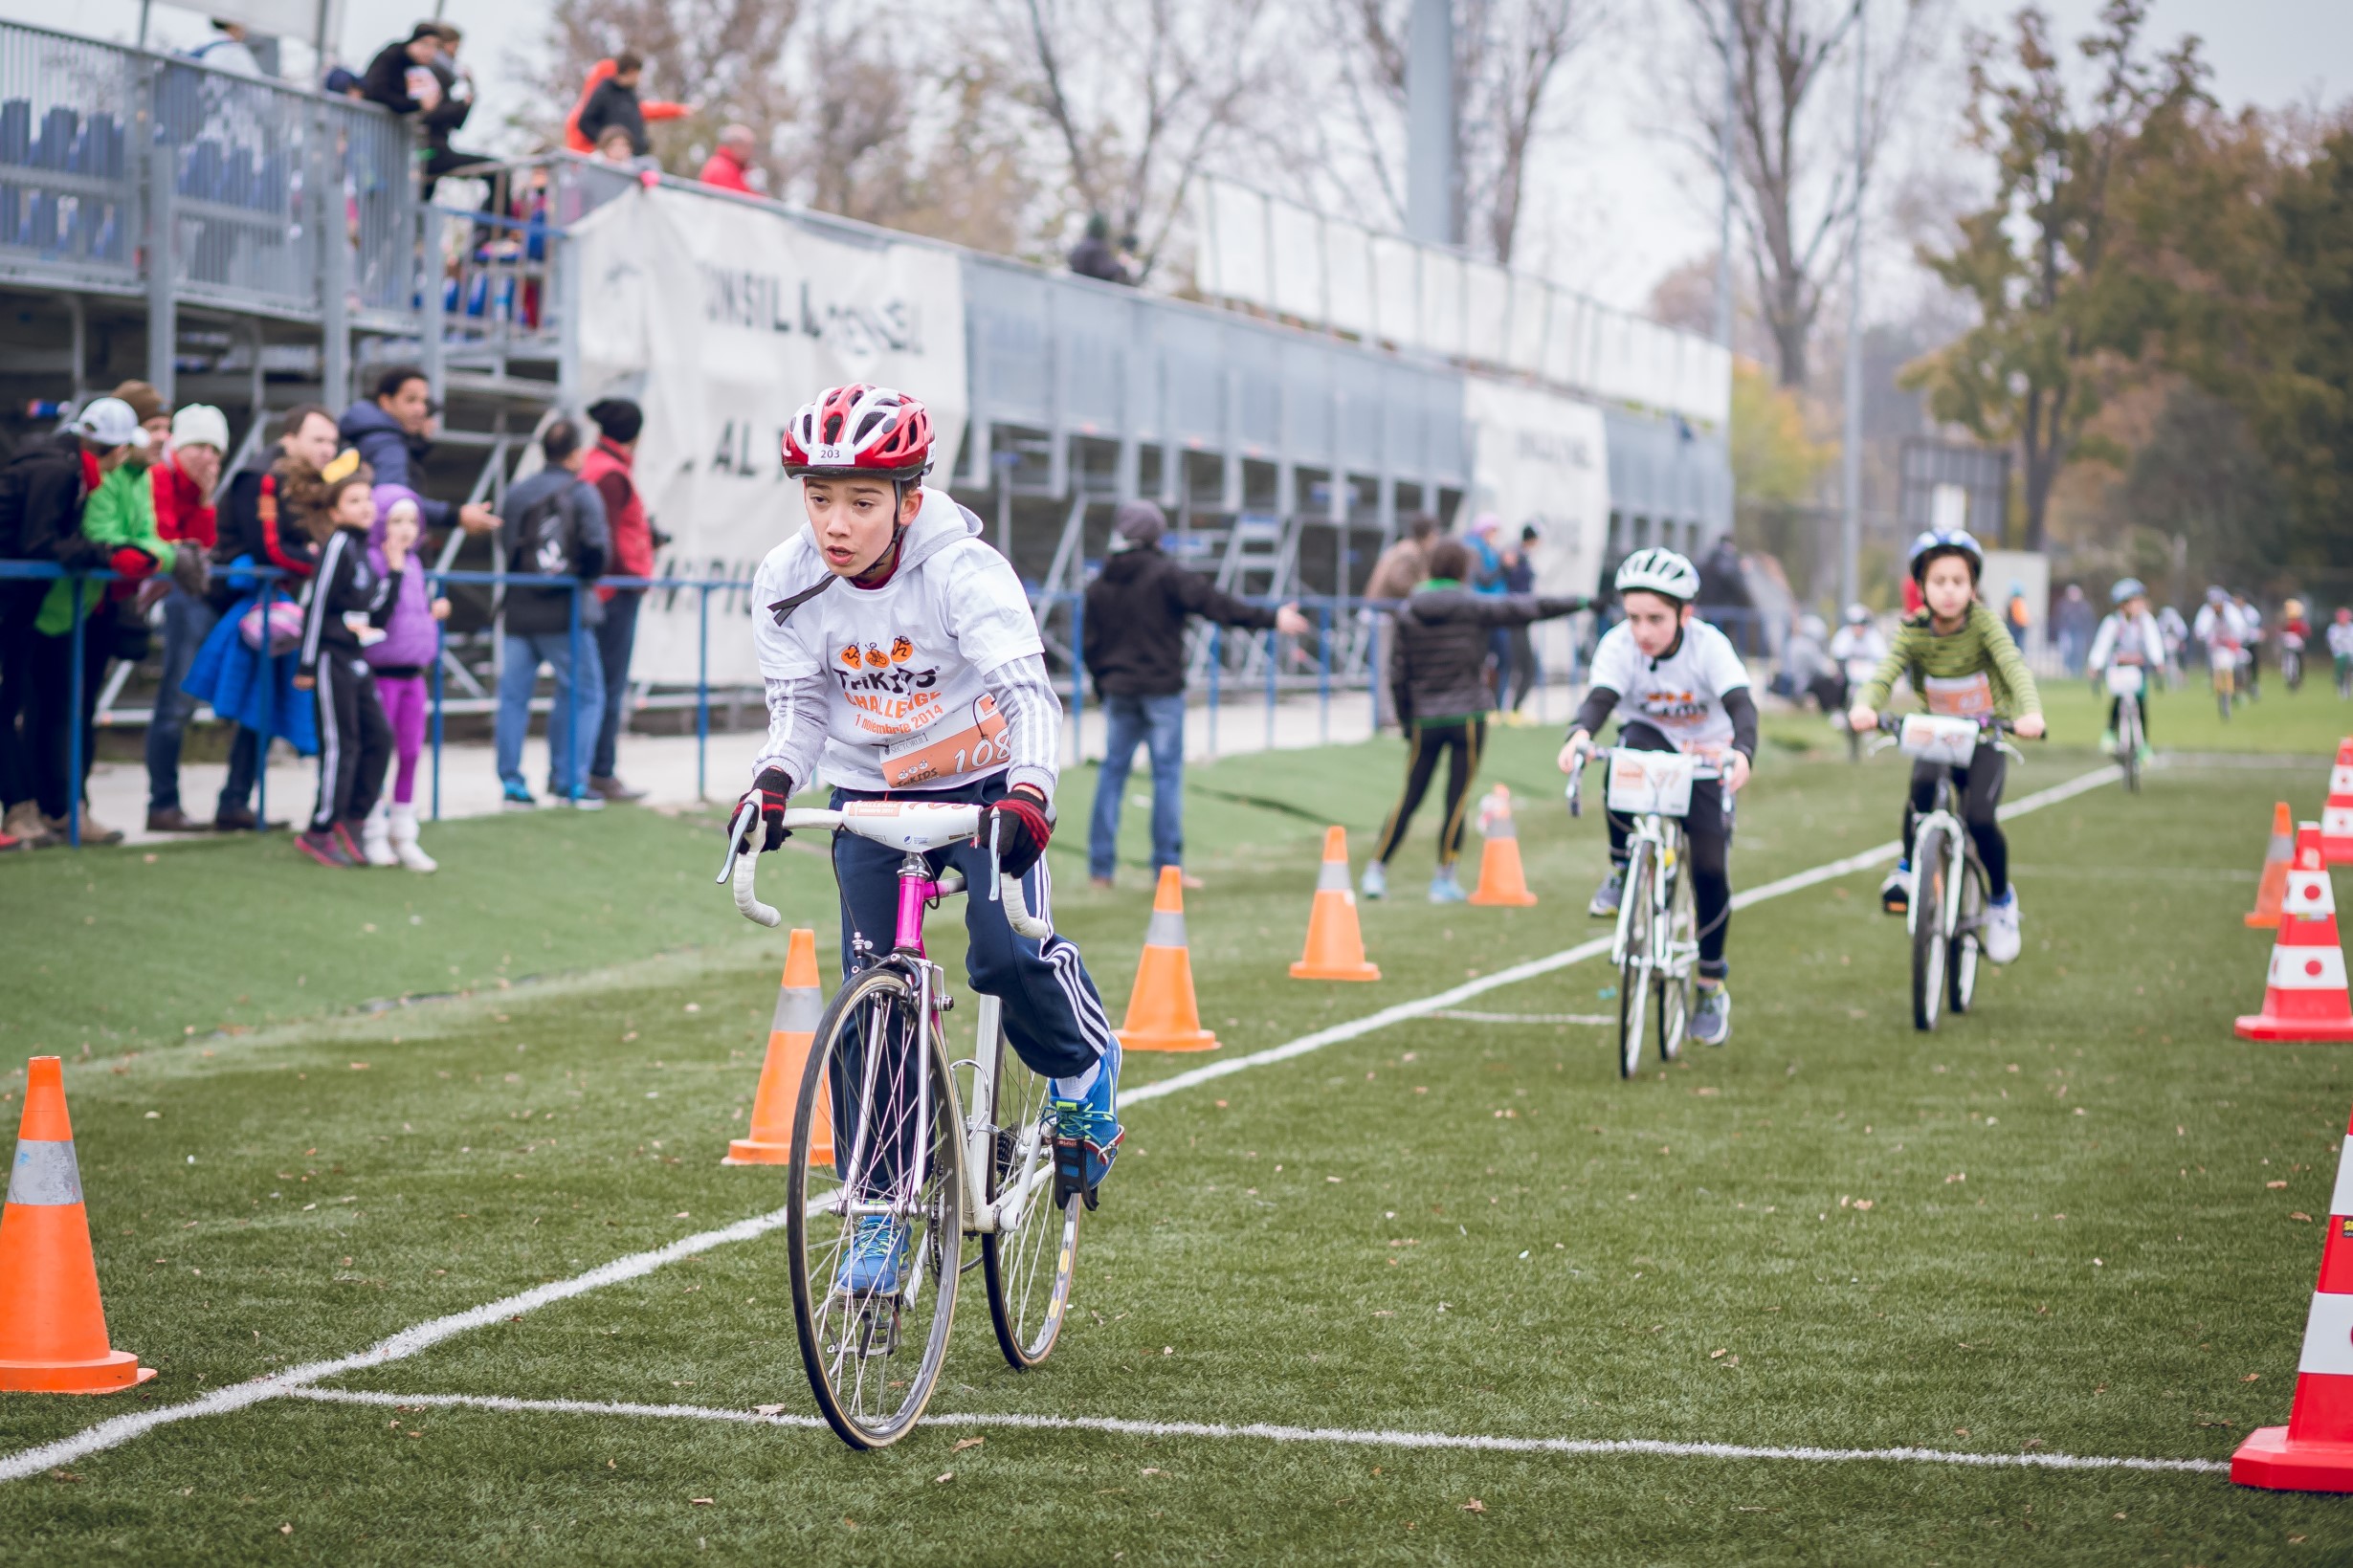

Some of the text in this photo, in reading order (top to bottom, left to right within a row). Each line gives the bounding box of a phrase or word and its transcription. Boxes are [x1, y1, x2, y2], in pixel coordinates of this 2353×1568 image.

[820, 450, 840, 458] 203
[844, 690, 942, 719] CHALLEGE
[855, 704, 943, 735] 1 noiembrie 2014
[921, 731, 929, 742] 1
